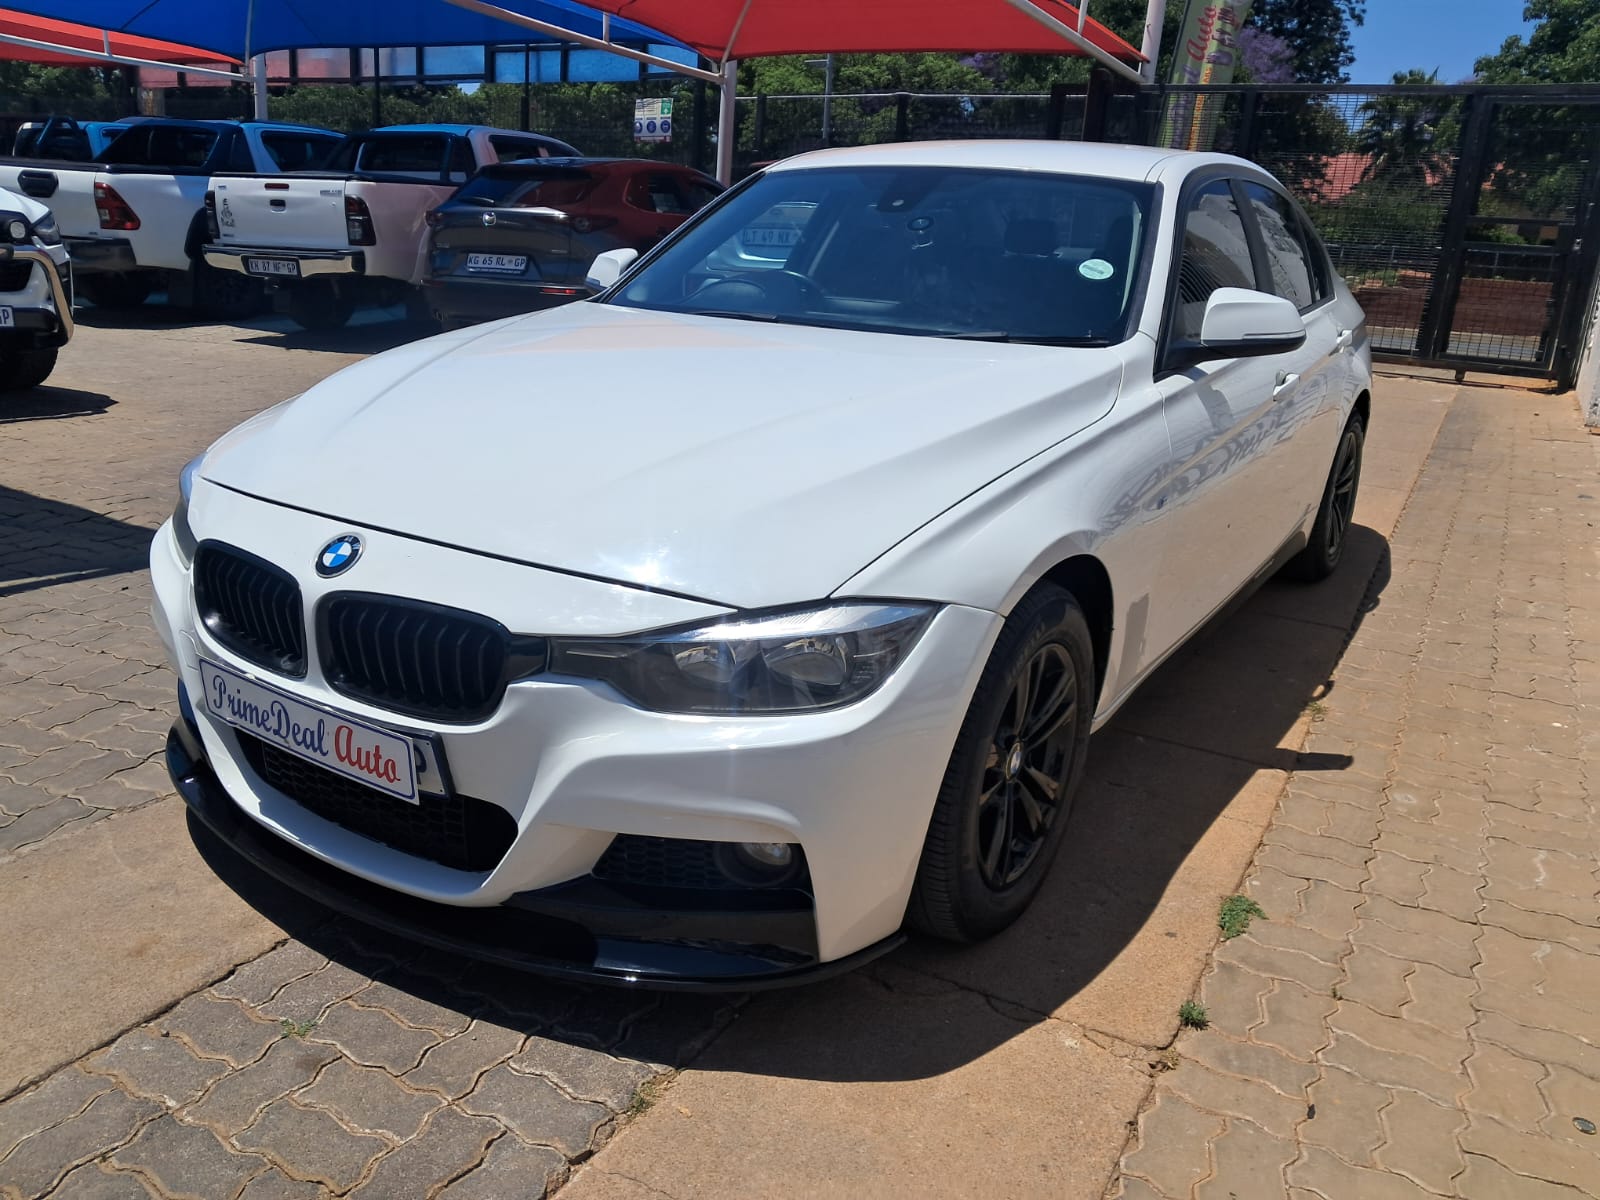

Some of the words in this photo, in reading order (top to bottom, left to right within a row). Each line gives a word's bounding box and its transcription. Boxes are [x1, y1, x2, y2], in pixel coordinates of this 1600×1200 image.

[1186, 5, 1217, 62] Auto
[468, 255, 479, 265] KG
[482, 256, 493, 266] 65
[496, 257, 506, 267] RL
[514, 257, 526, 268] GP
[0, 309, 10, 325] P
[212, 674, 329, 757] PrimeDeal
[334, 724, 401, 784] Auto
